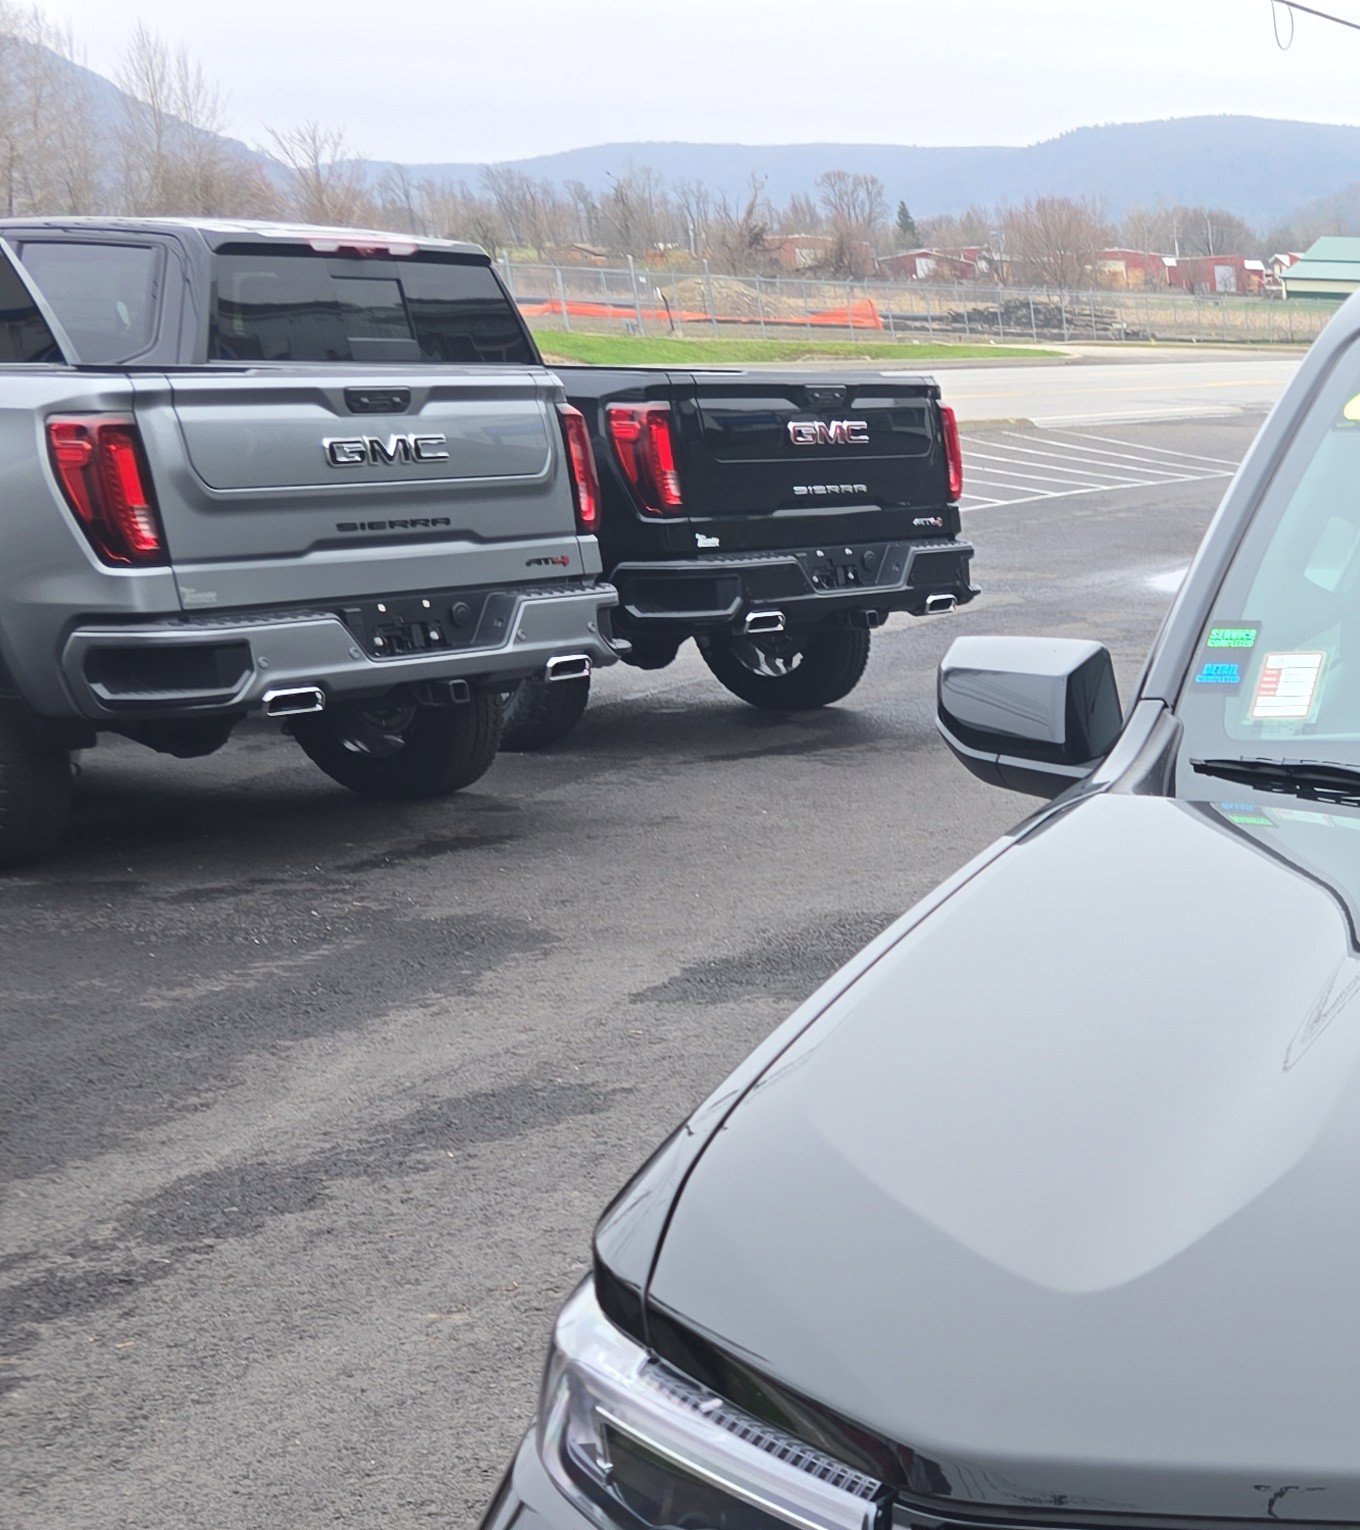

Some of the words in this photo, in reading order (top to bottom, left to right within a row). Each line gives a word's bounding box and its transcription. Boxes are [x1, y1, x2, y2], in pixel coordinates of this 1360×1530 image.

[788, 420, 869, 445] GMC
[322, 434, 449, 467] GMC
[793, 484, 867, 495] SIERRA
[336, 517, 451, 532] SIERRA
